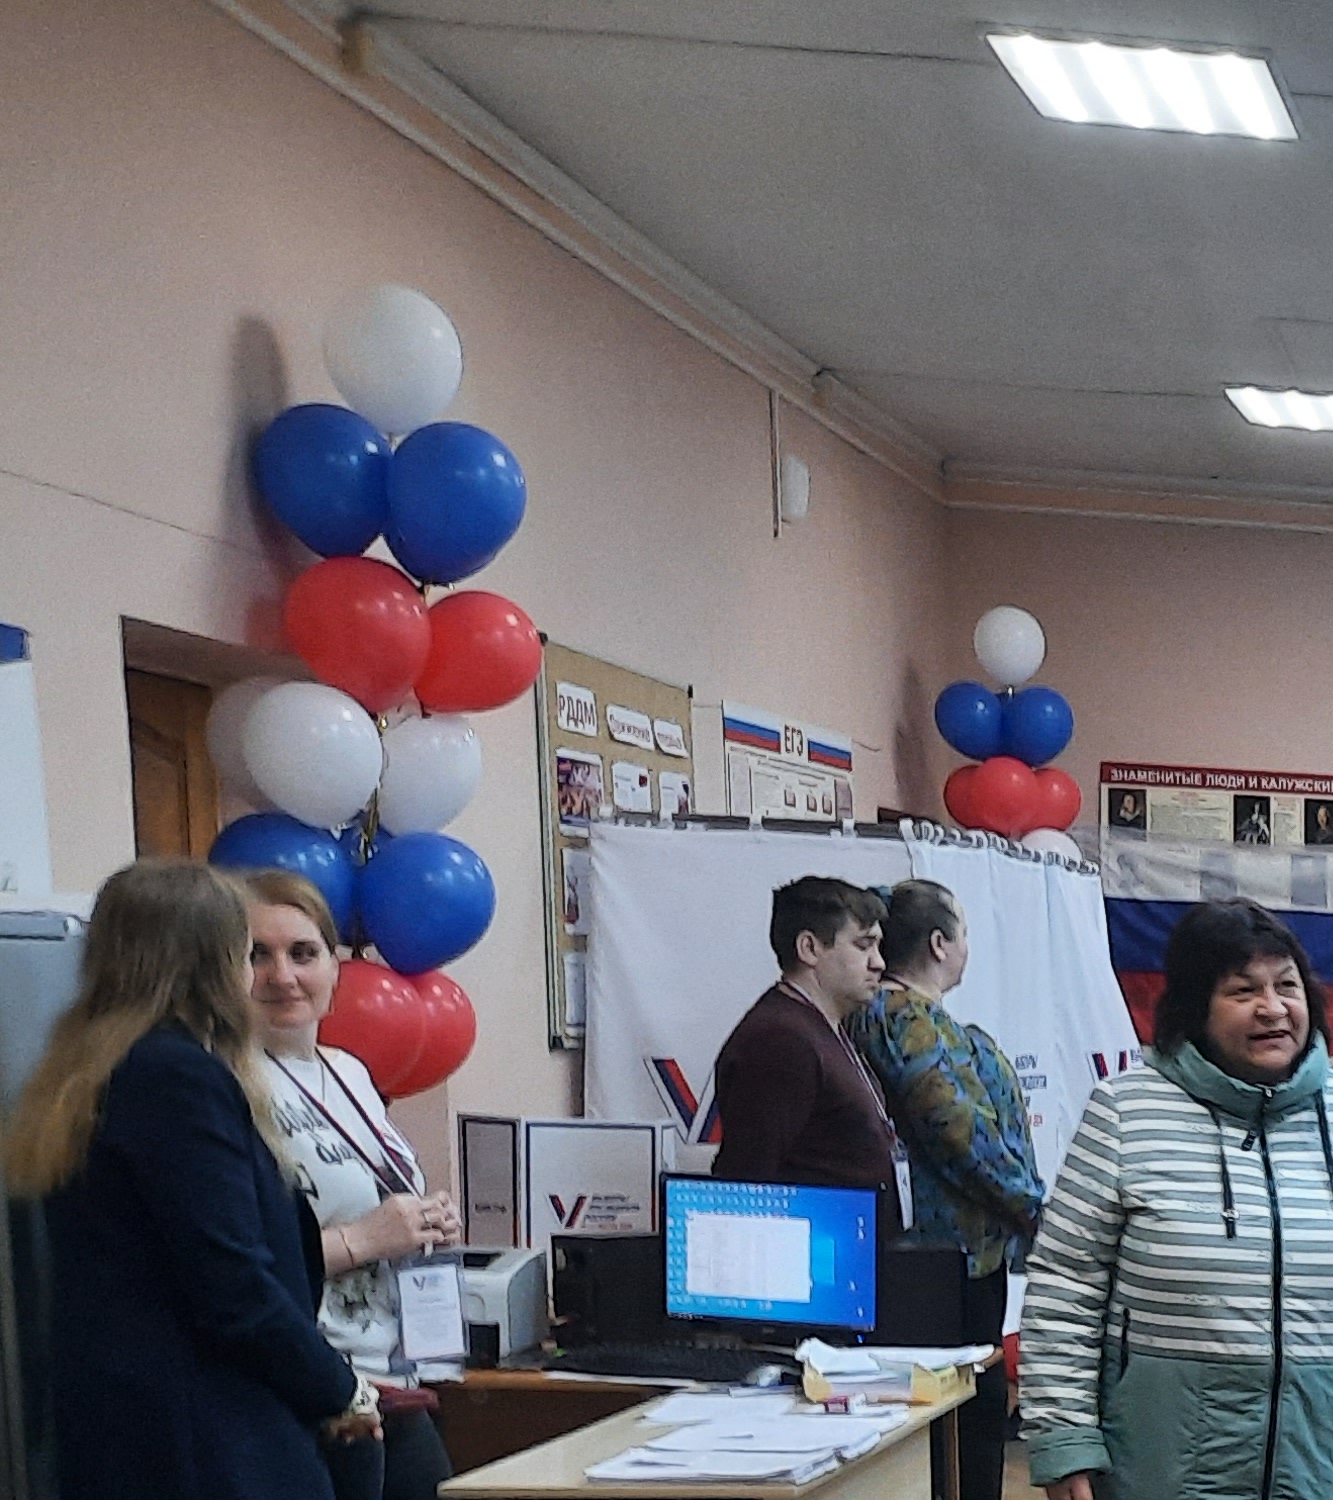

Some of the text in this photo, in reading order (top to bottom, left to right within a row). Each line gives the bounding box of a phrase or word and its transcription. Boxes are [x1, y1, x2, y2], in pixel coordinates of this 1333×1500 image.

[784, 724, 804, 756] ЕГЭ
[1110, 768, 1202, 786] ЗНАМЕНИТЫЕ
[1205, 773, 1246, 789] ЛЮДИ
[1248, 775, 1258, 789] И
